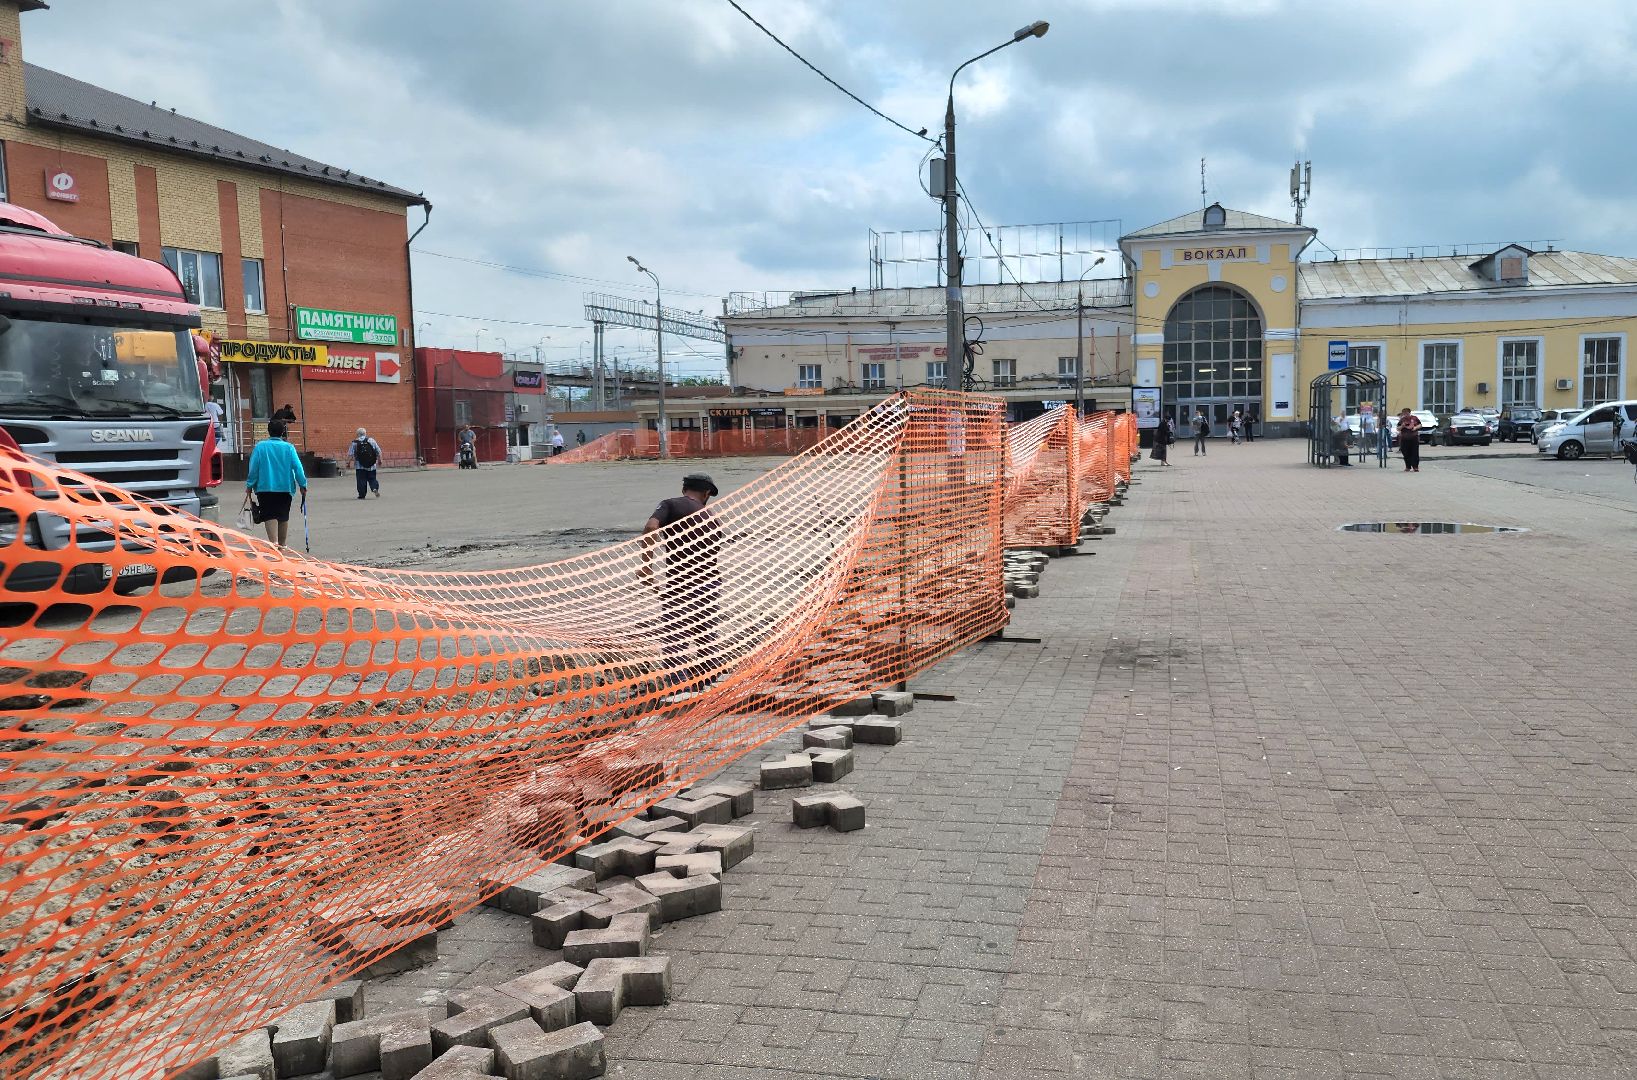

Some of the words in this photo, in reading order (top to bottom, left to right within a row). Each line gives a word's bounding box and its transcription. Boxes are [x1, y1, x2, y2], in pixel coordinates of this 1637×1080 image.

[1184, 248, 1246, 261] ВОКЗАЛ
[299, 310, 395, 332] ПАМЯТНИКИ
[221, 341, 317, 362] ПРОДУКТЫ
[710, 409, 750, 417] СКУПКА
[91, 428, 154, 443] SCANIA
